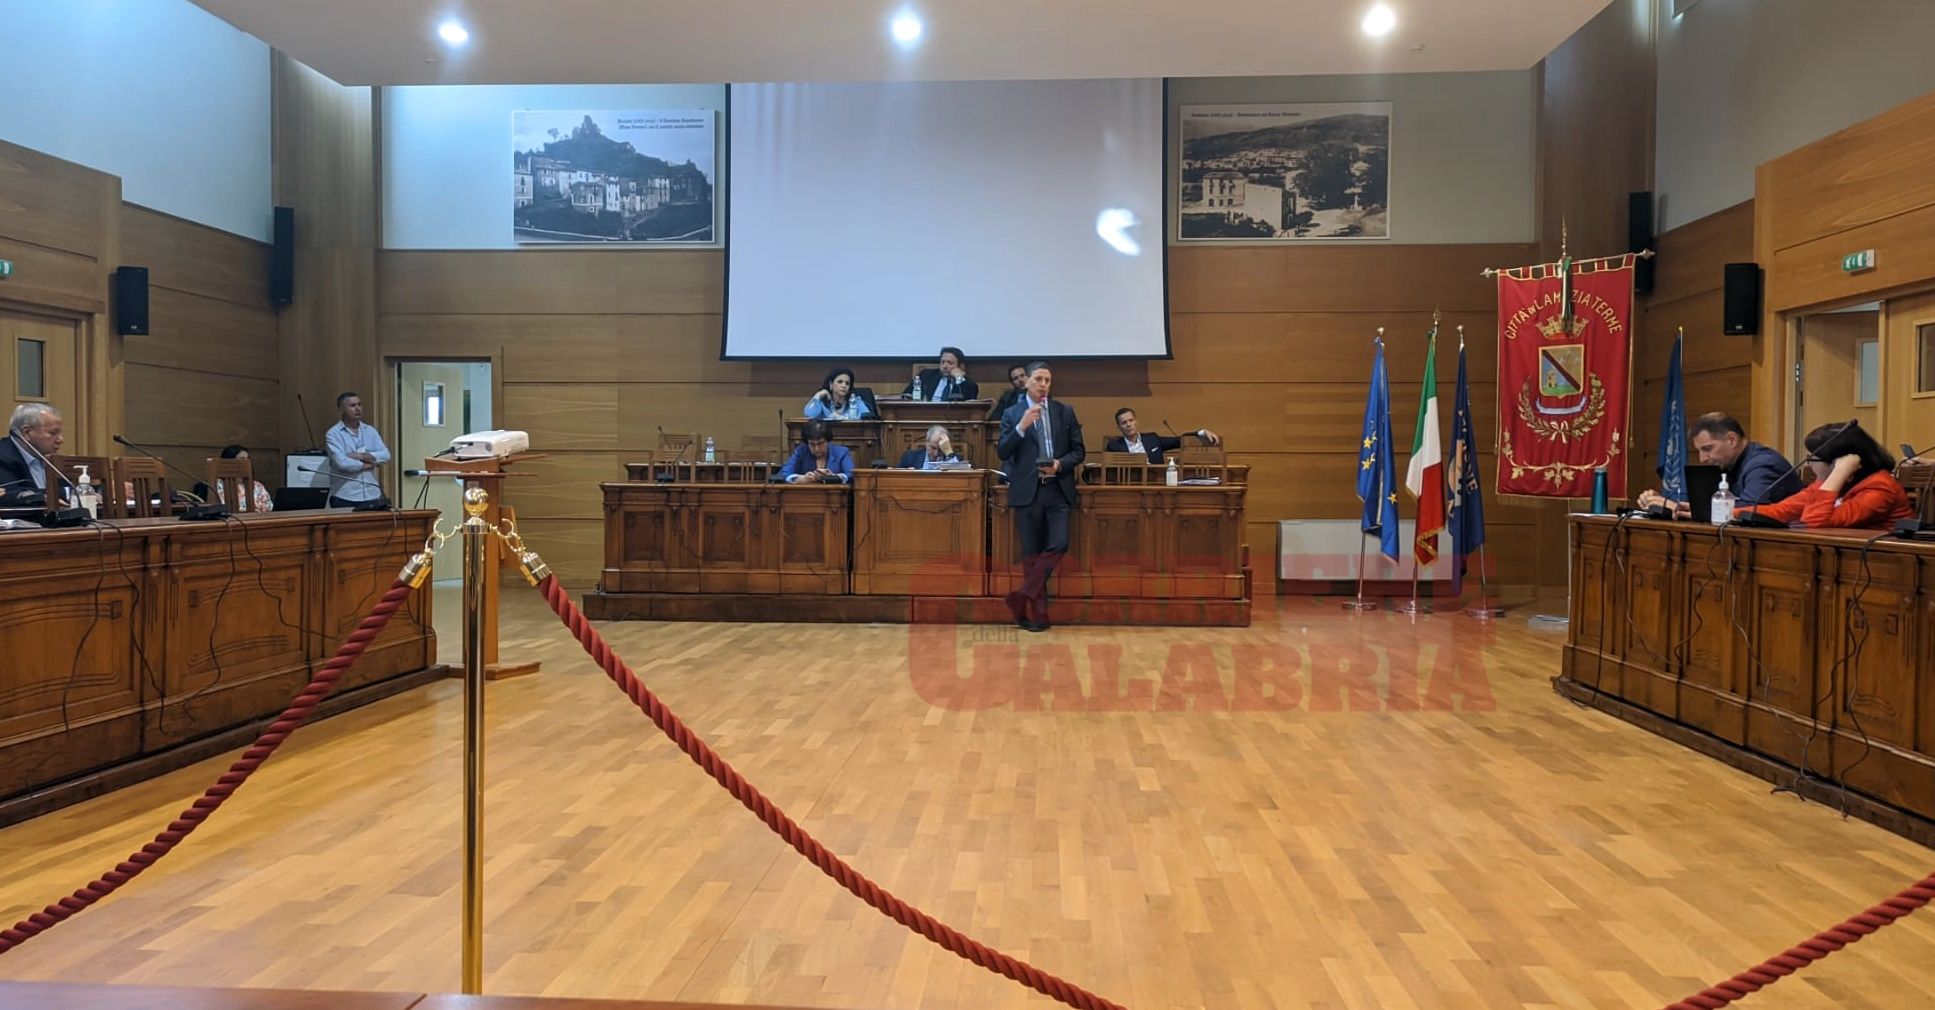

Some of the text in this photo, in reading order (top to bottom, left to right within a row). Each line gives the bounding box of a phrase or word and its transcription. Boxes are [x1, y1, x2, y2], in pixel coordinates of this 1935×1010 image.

[1504, 307, 1530, 339] CITTÀ
[1533, 289, 1591, 310] LAMZIA
[1591, 296, 1623, 334] TERME
